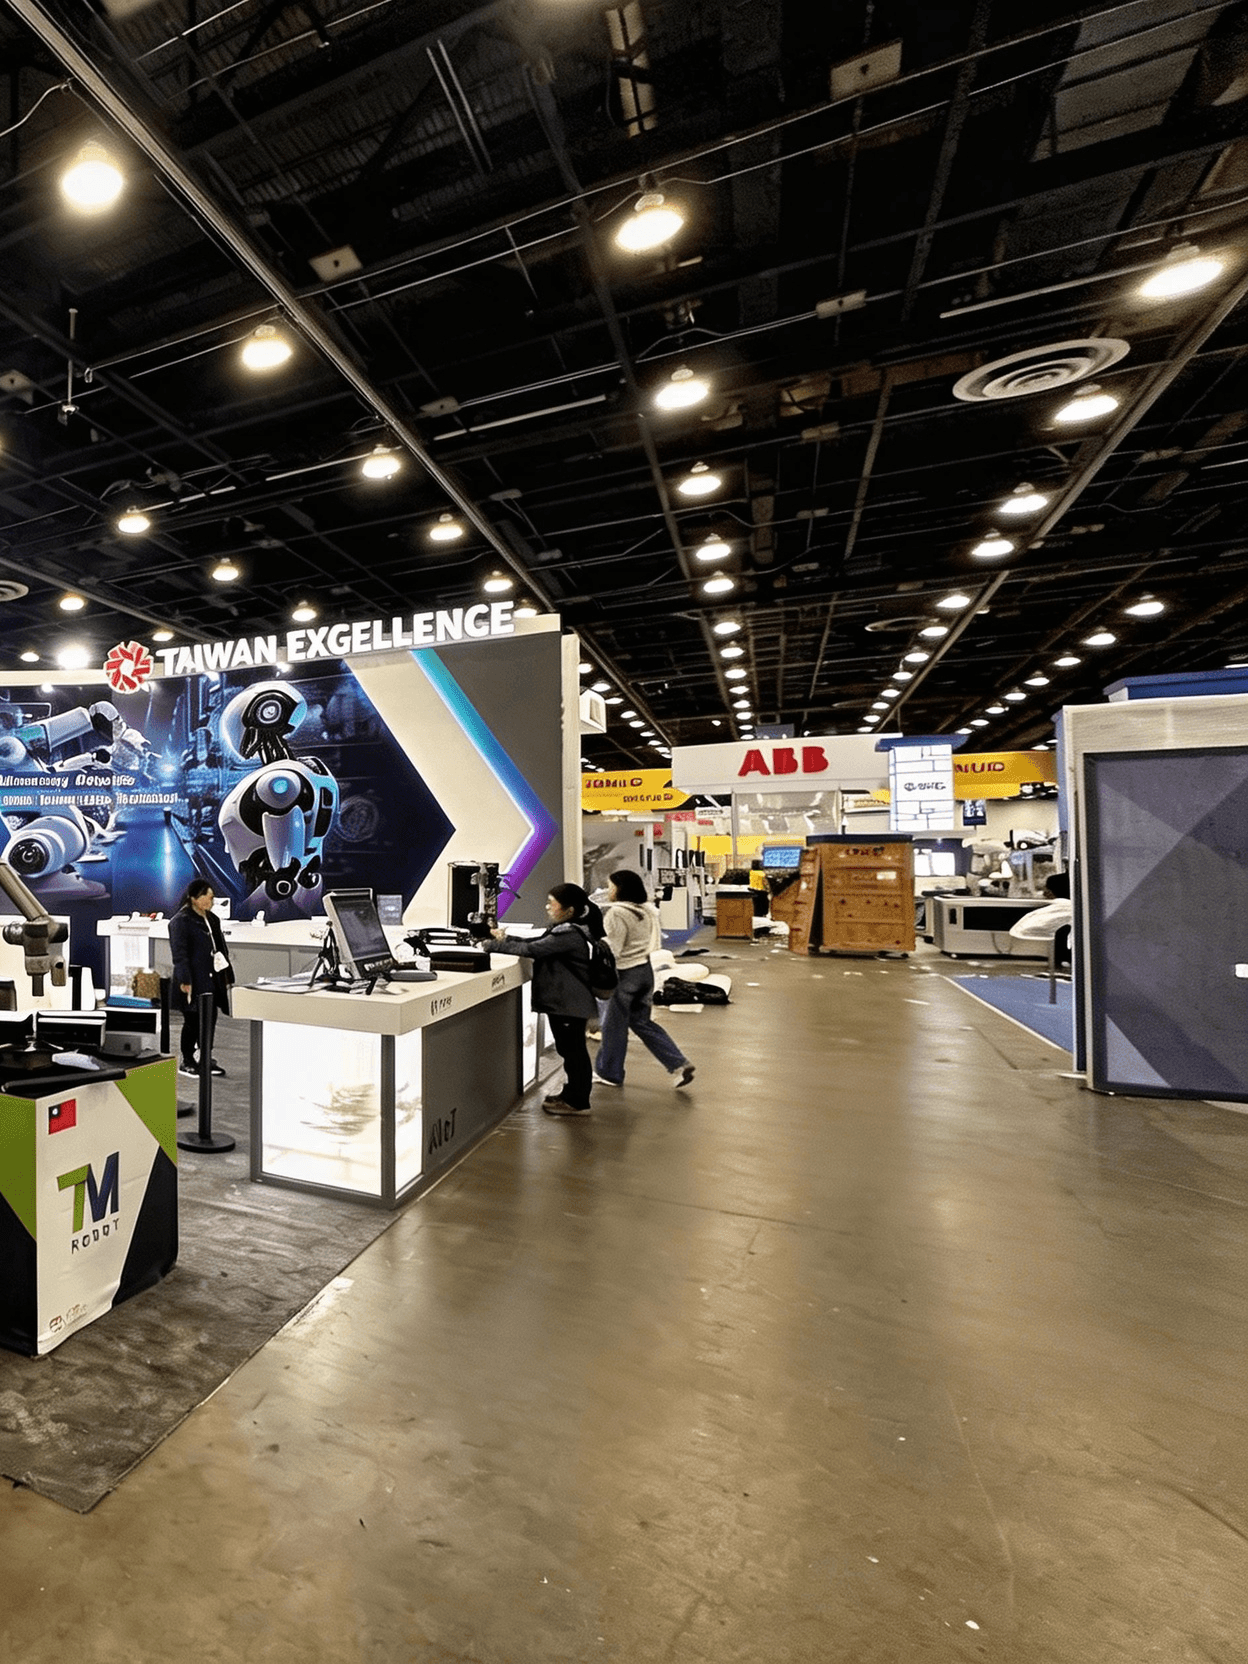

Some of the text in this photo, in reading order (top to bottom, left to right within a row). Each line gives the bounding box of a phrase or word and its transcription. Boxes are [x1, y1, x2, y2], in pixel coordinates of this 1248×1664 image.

[155, 635, 277, 676] TAIWAN
[737, 746, 830, 777] ABB
[56, 1151, 120, 1234] TM
